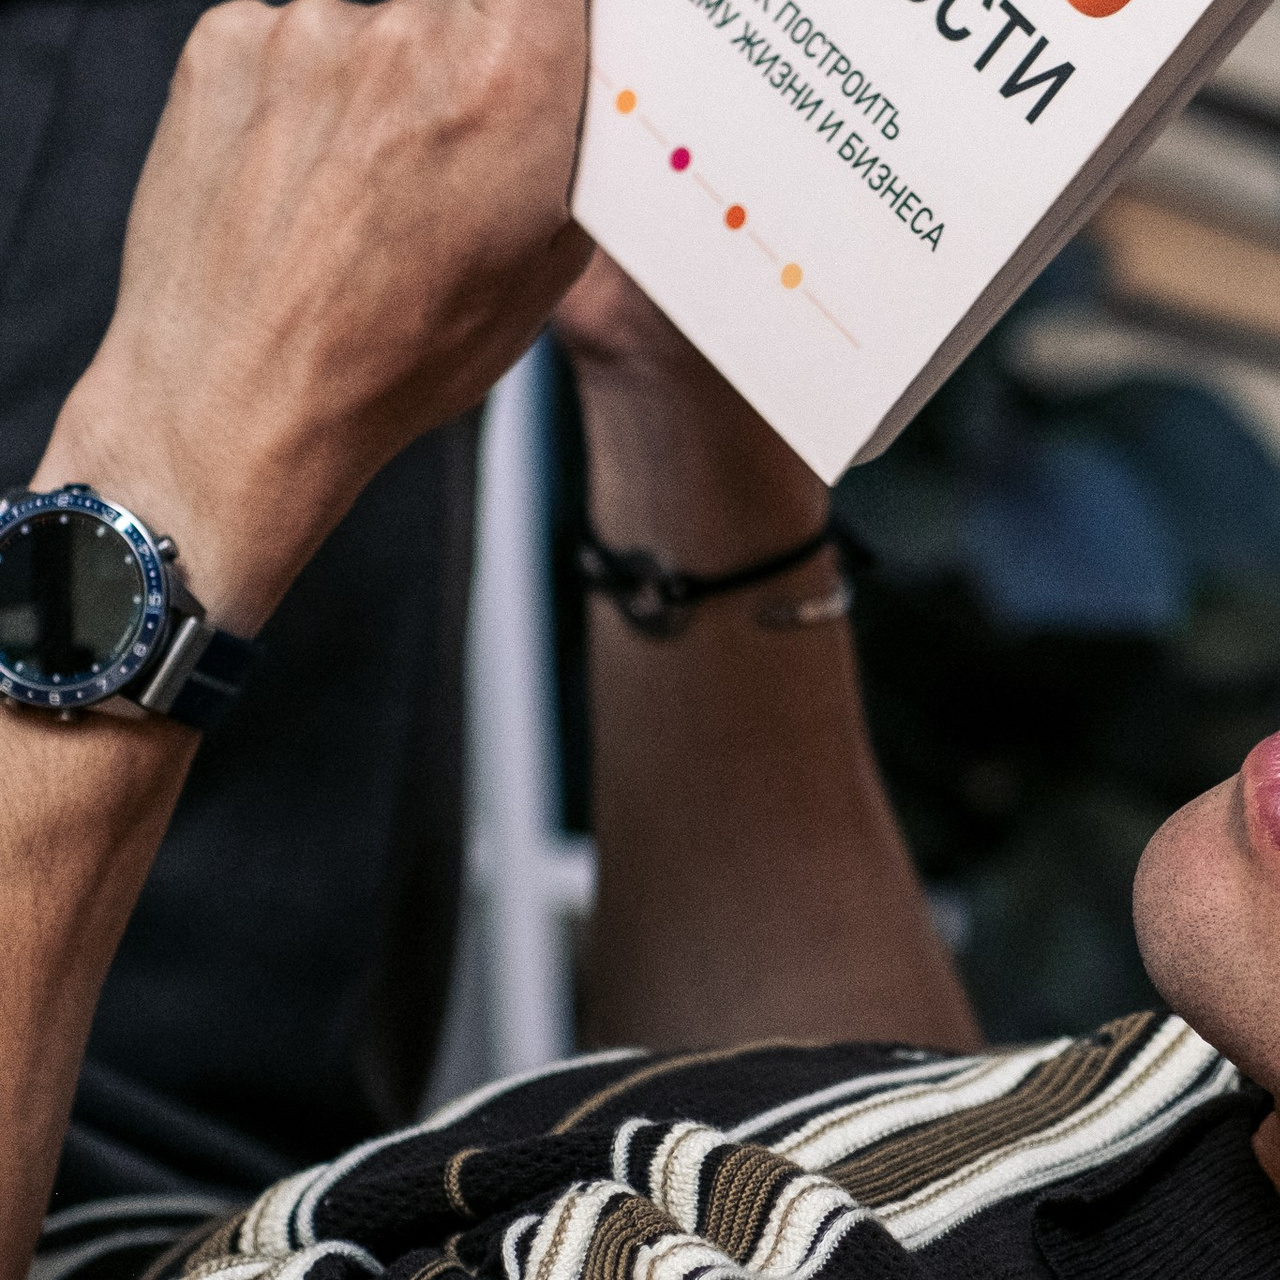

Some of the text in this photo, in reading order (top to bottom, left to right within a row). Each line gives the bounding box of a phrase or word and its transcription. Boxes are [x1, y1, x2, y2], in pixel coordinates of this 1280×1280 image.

[731, 20, 823, 122] ЖИЗНИ
[816, 111, 845, 143] И
[837, 132, 946, 252] БИЗНЕСА
[775, 0, 902, 141] ПОСТРОИТЬ
